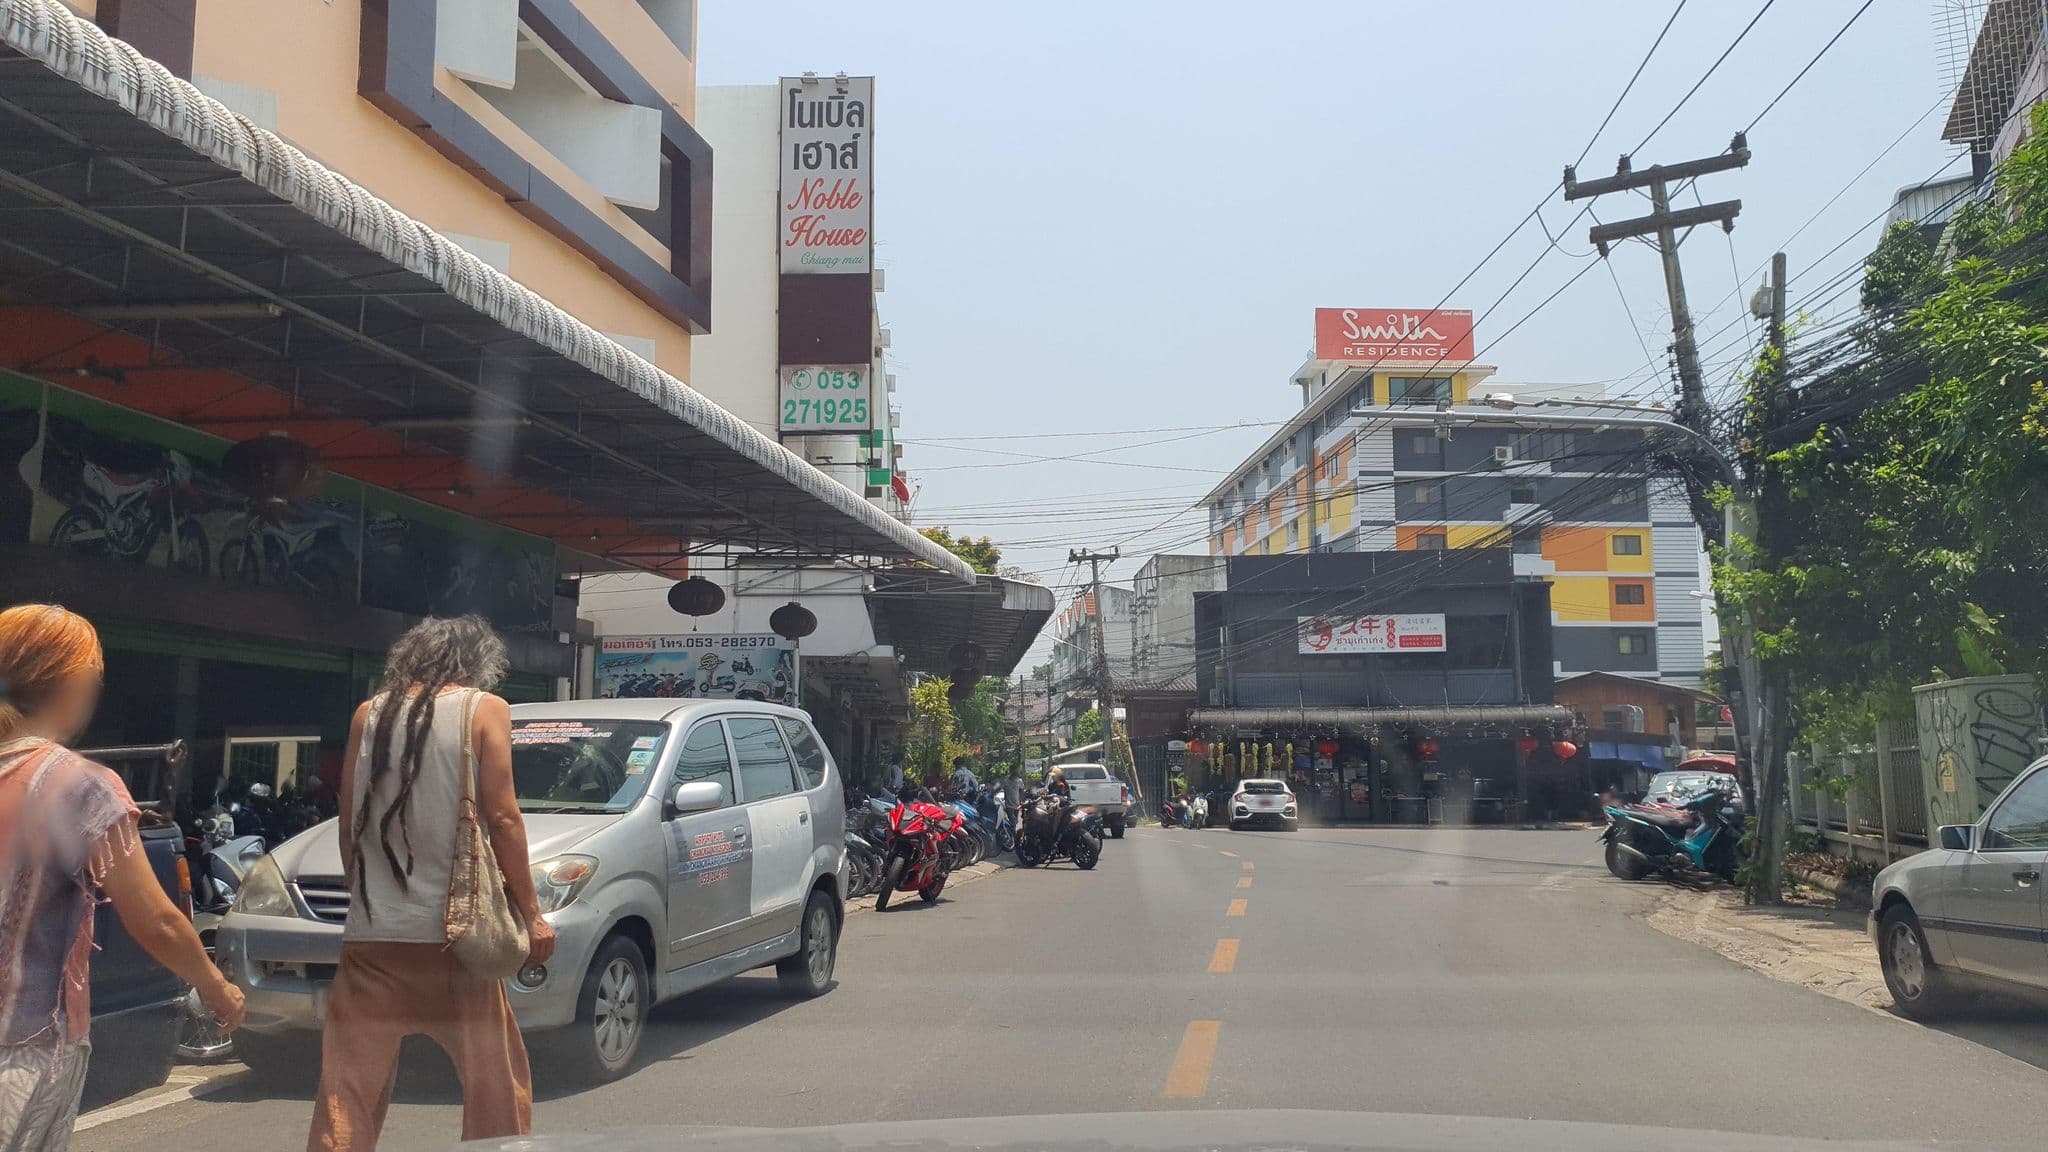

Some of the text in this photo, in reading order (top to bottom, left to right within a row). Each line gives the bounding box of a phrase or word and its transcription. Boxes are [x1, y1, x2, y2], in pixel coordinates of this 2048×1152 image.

[788, 87, 865, 129] โนเบิ้ล
[793, 132, 860, 170] เฮาส์
[787, 177, 864, 211] Noble
[785, 214, 867, 248] House
[1342, 309, 1448, 341] Smith
[1344, 347, 1449, 357] RESIDENCE
[817, 371, 860, 389] 053
[783, 399, 867, 424] 271925
